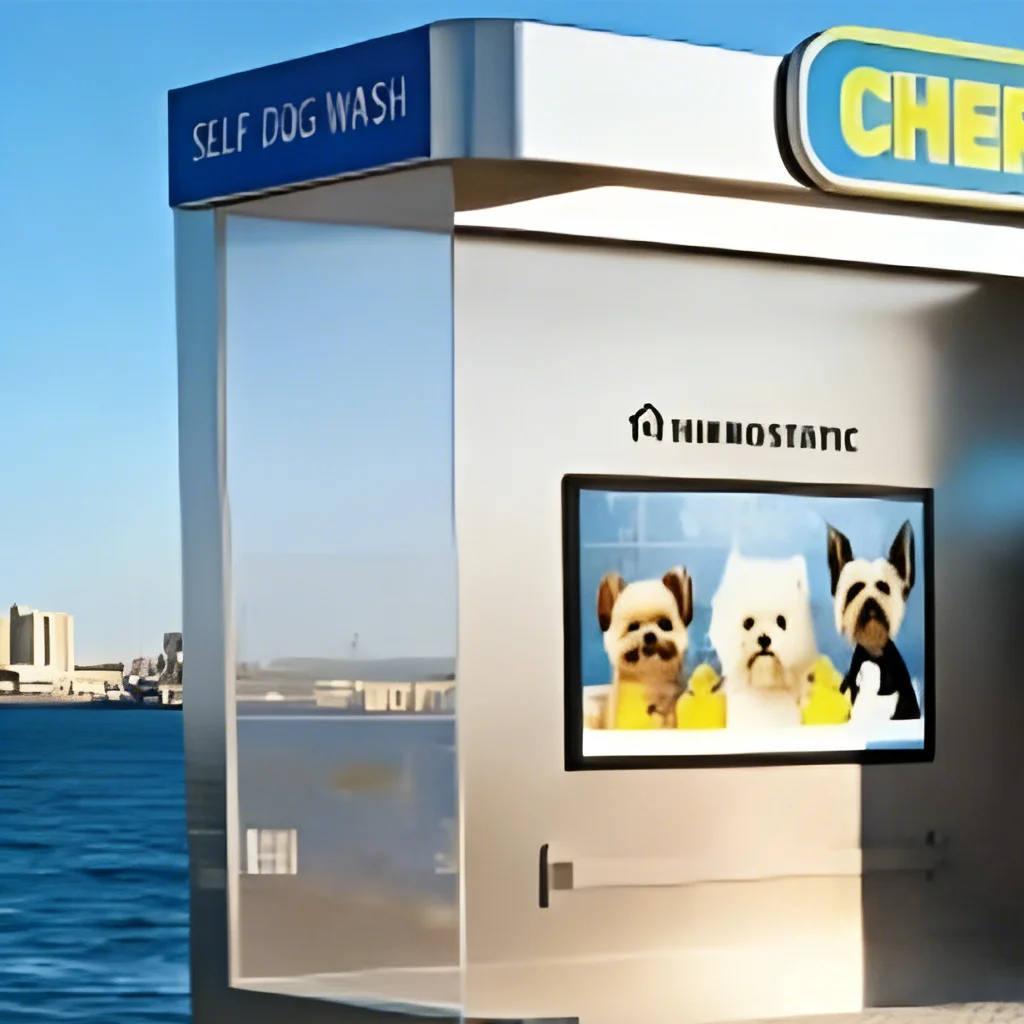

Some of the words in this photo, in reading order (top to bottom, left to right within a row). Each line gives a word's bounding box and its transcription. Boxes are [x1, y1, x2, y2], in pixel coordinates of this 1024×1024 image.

[192, 111, 250, 163] SELF
[262, 97, 317, 149] DOG
[325, 75, 407, 134] WASH
